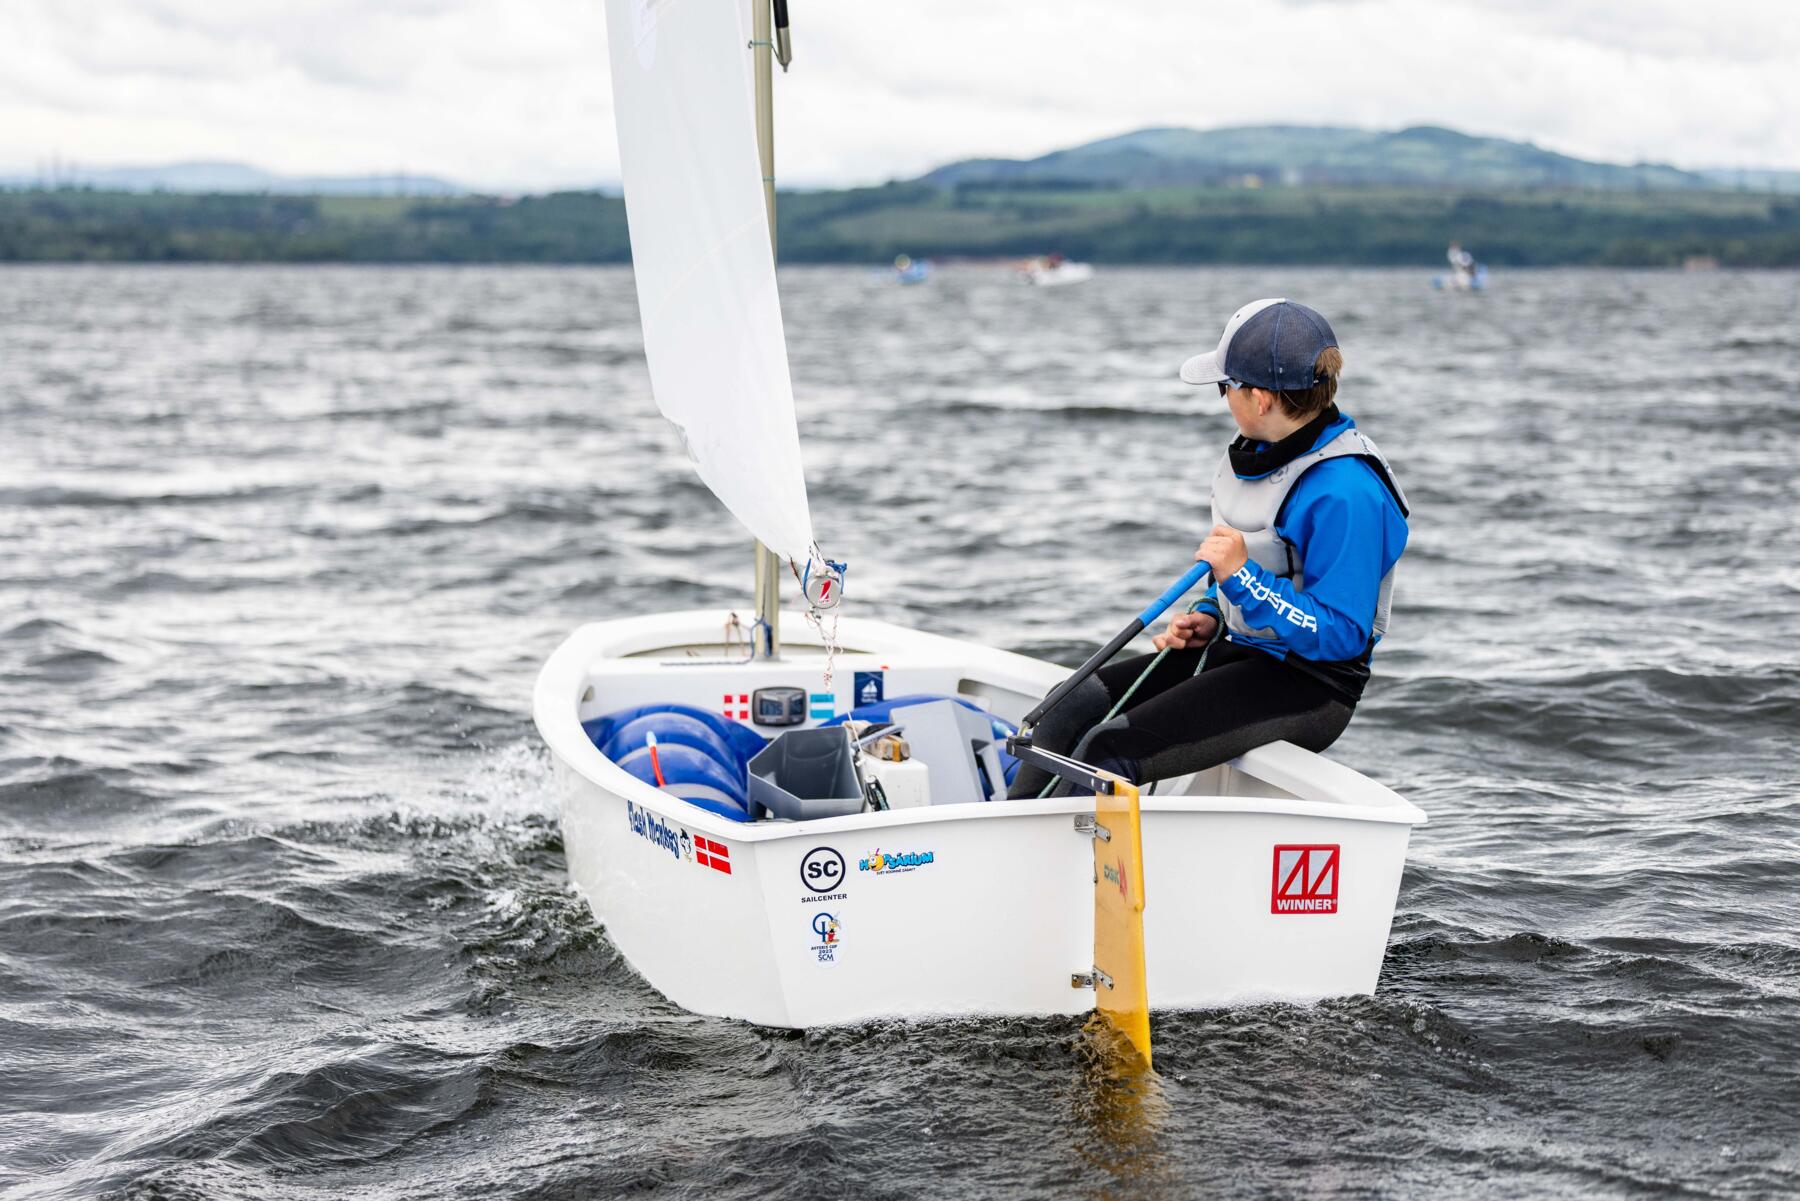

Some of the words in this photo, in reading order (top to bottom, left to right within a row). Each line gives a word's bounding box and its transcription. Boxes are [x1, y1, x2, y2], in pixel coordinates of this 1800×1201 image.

[808, 860, 839, 879] SC
[801, 893, 847, 903] SAILCENTER
[1277, 899, 1332, 911] WINNER
